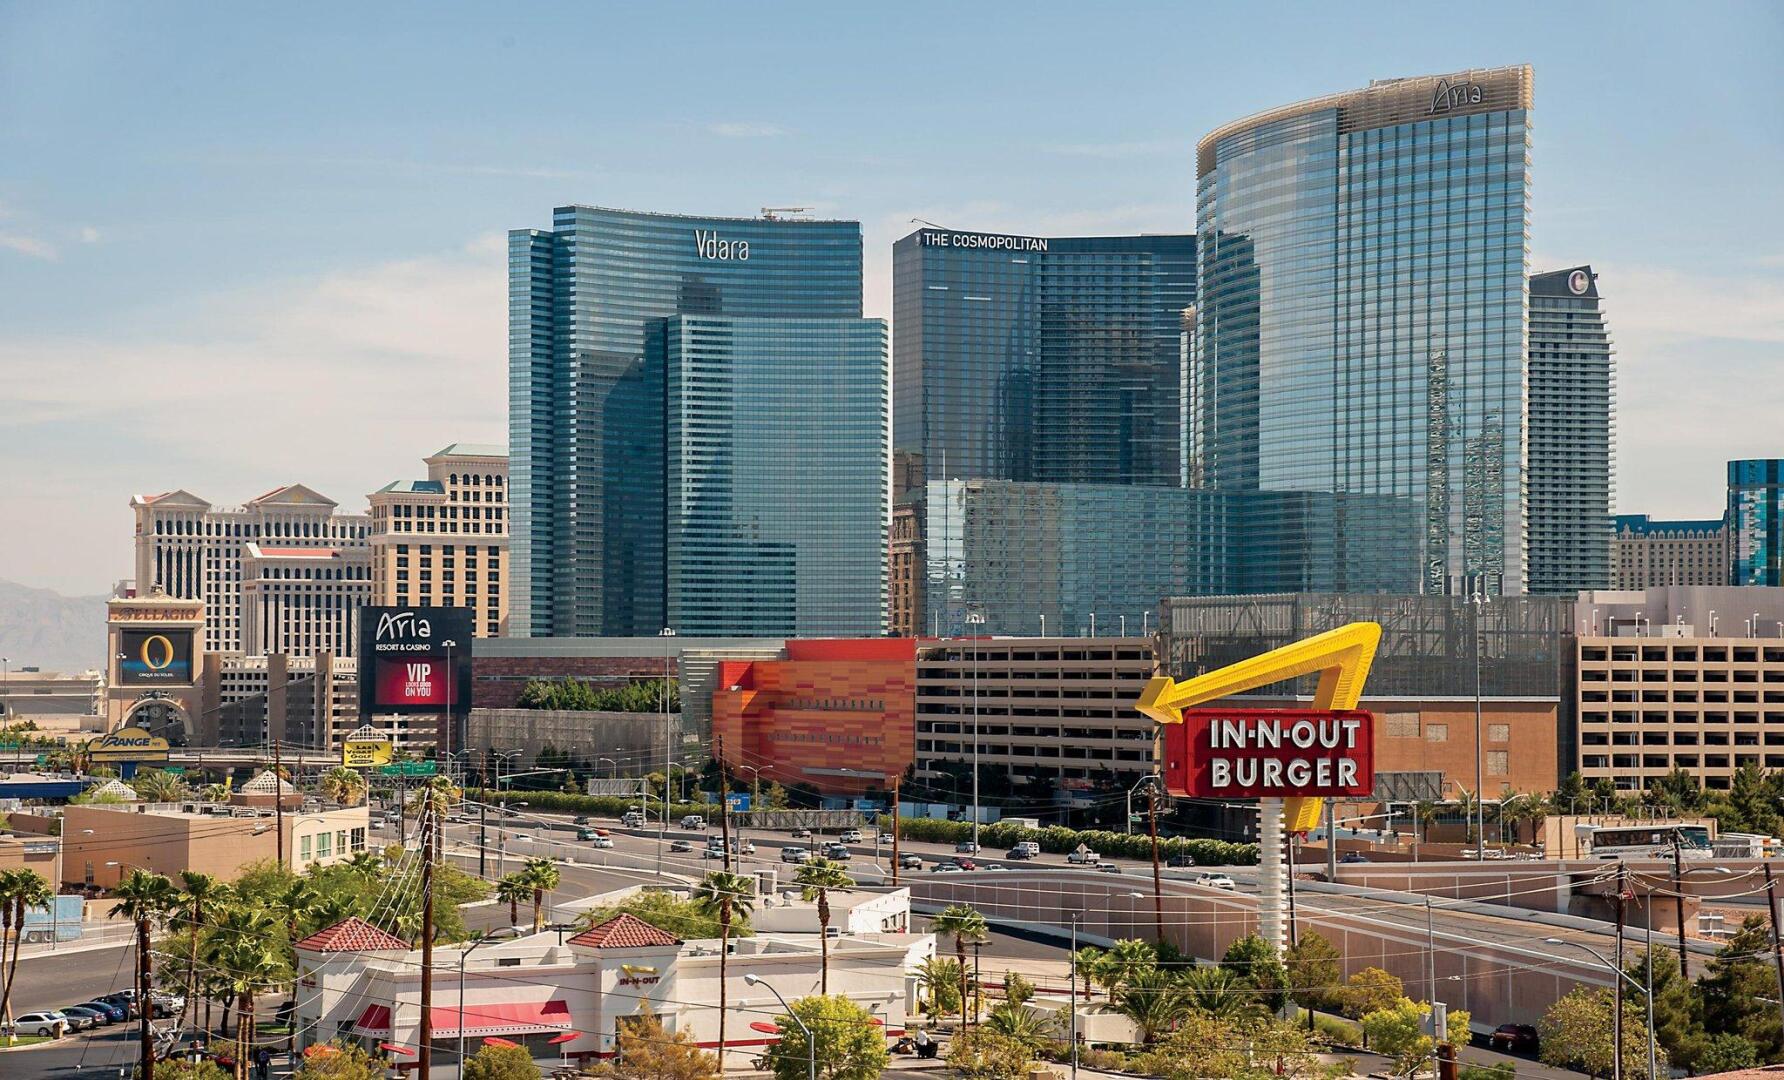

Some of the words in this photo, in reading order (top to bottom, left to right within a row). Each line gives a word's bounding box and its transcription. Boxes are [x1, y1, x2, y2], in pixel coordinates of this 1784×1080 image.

[1430, 79, 1483, 114] Aria
[695, 229, 749, 261] Vdara
[924, 233, 948, 246] THE
[952, 234, 1048, 251] COSMOPOLITAN
[375, 611, 431, 641] Aria
[139, 634, 174, 670] O
[375, 643, 399, 651] RESORT
[400, 643, 405, 651] &
[405, 643, 431, 651] CASINO
[406, 663, 431, 682] VIP
[405, 688, 416, 696] ON
[416, 688, 431, 696] YOU
[104, 736, 151, 747] RANGE
[1212, 757, 1359, 788] BURGER
